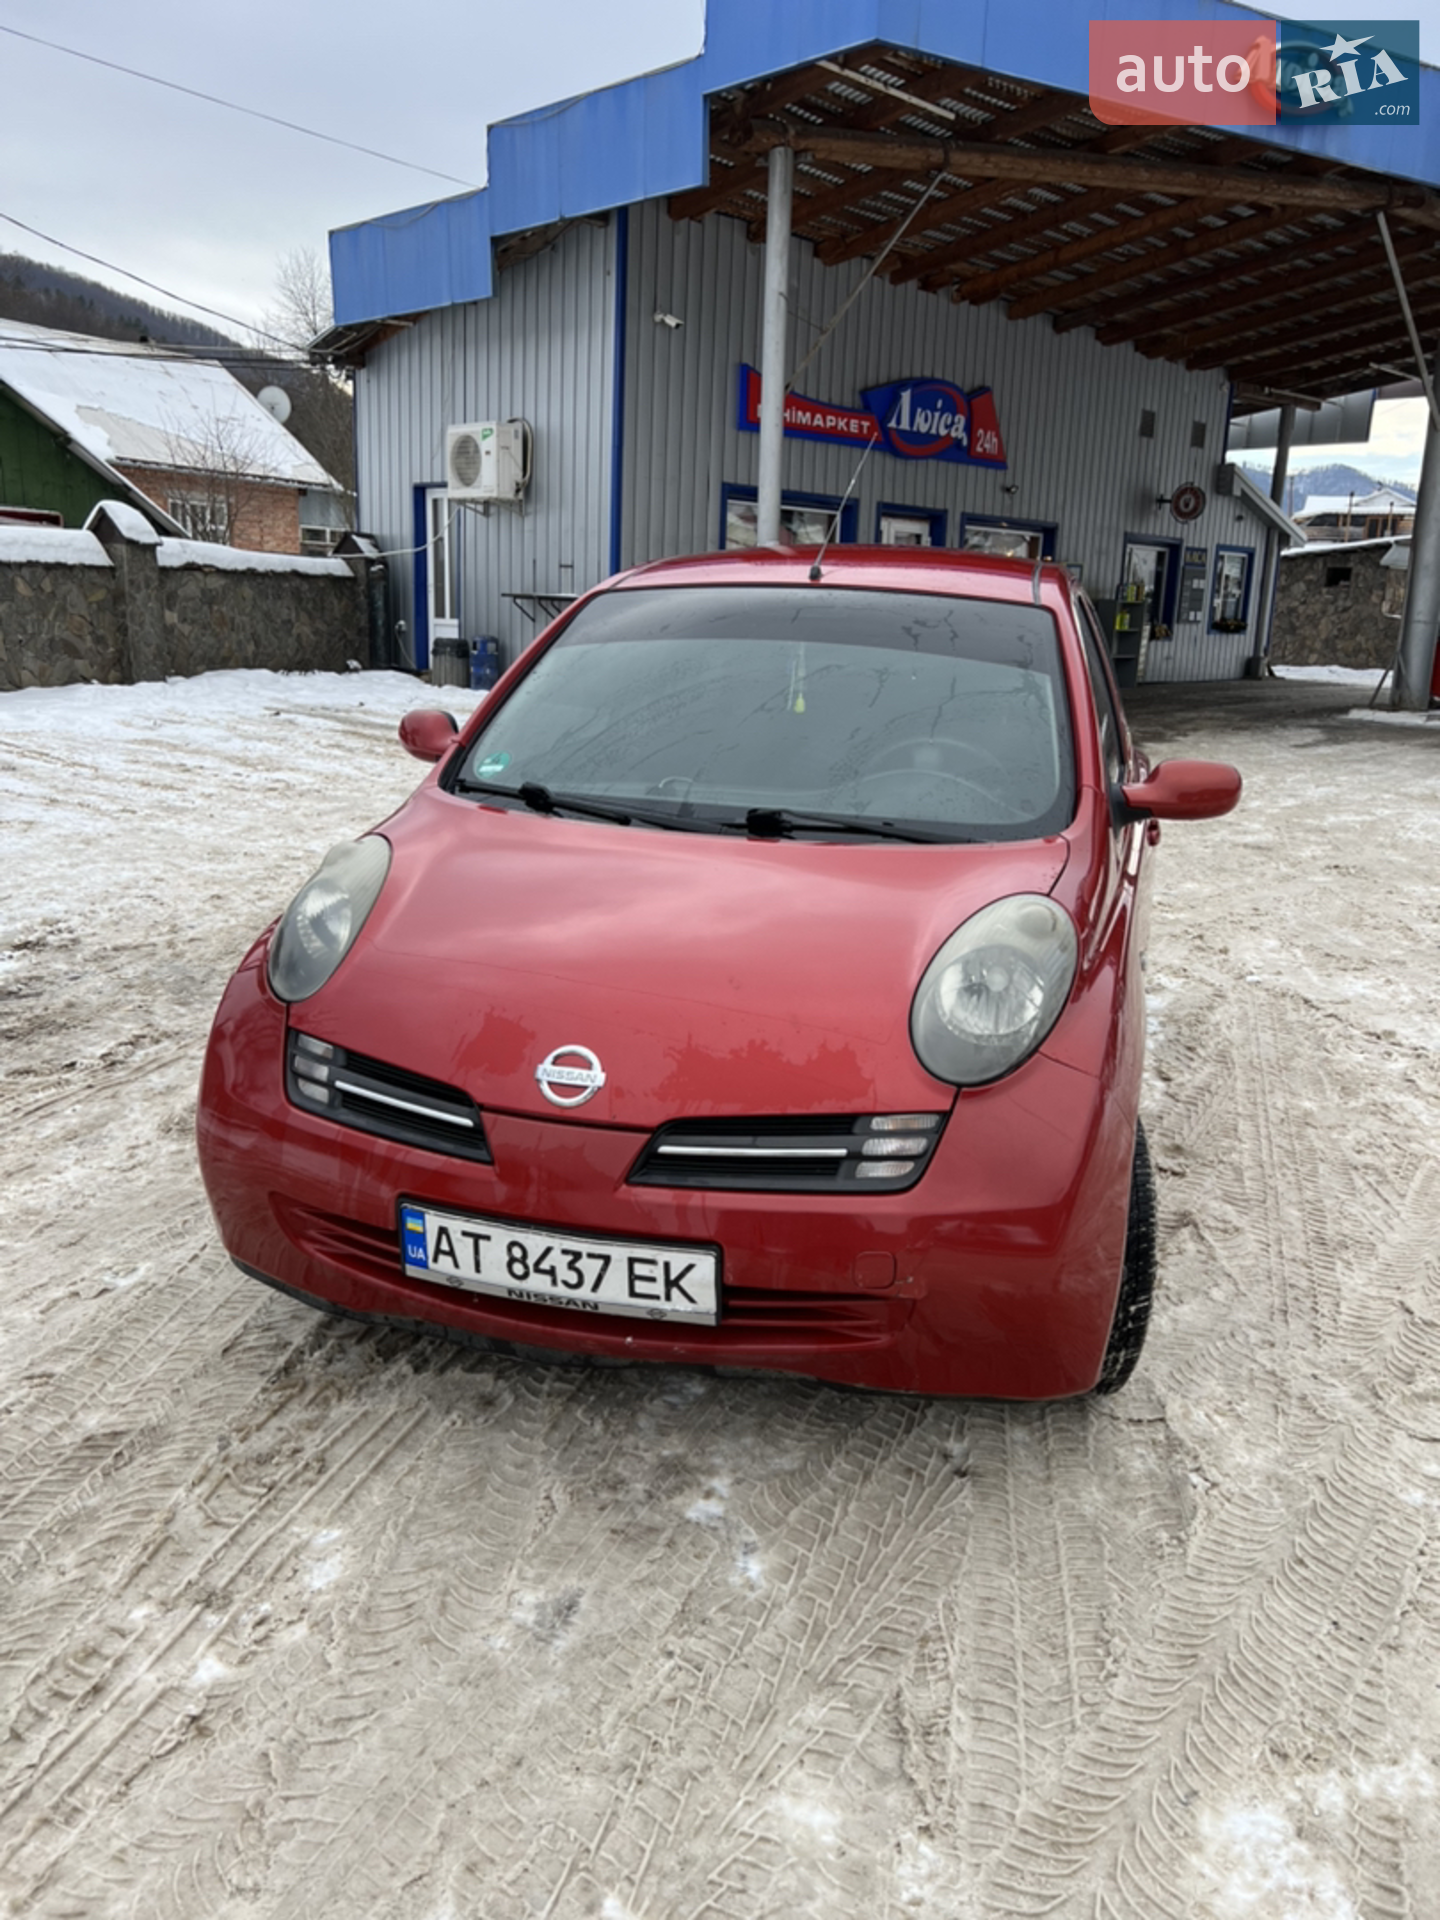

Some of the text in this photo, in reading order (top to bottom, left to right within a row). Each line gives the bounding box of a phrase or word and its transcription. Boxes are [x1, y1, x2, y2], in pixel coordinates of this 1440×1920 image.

[975, 428, 999, 455] 24h
[542, 1068, 597, 1083] NISSAN
[408, 1244, 426, 1261] UA
[432, 1226, 698, 1304] AT 8437 EK
[506, 1288, 600, 1311] NISSAN
